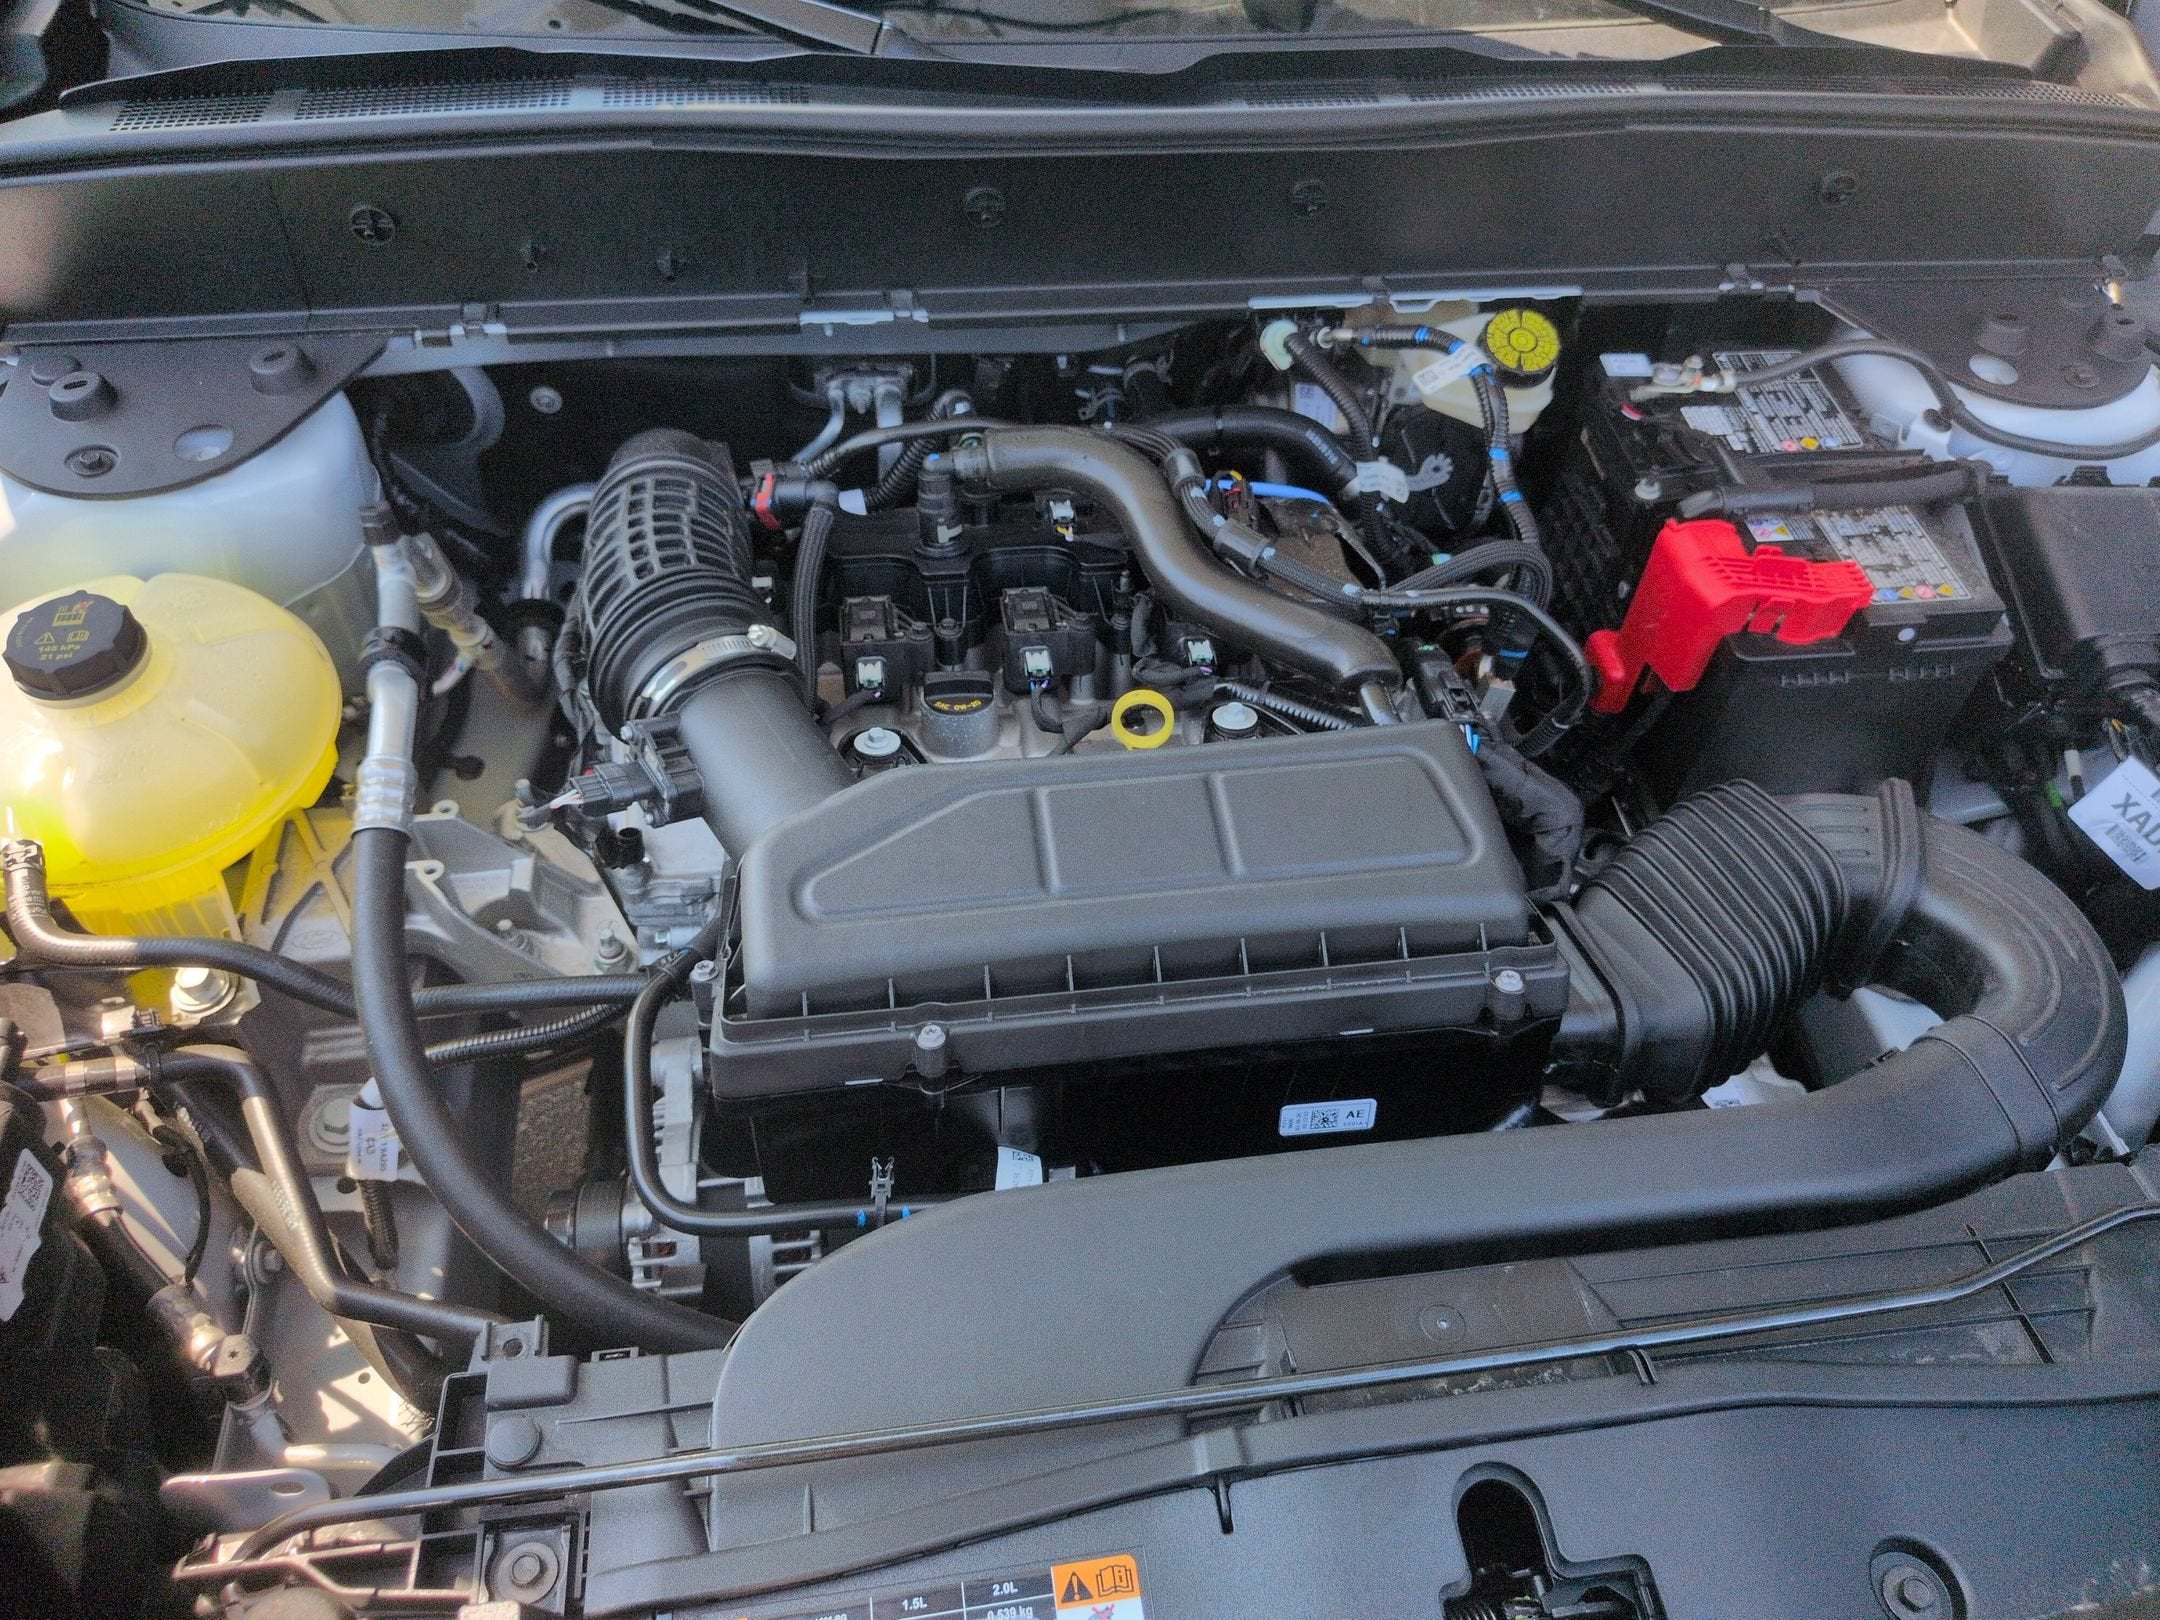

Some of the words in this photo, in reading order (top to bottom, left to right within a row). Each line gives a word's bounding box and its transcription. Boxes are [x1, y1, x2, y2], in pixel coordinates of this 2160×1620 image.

[61, 644, 81, 652] kPa
[57, 653, 73, 661] psi
[934, 700, 951, 710] SAE
[1346, 1109, 1365, 1119] AE
[901, 1597, 927, 1611] 1.5L
[992, 1581, 1018, 1596] 2.0L
[986, 1605, 1017, 1620] 0.539
[1018, 1604, 1034, 1619] kg
